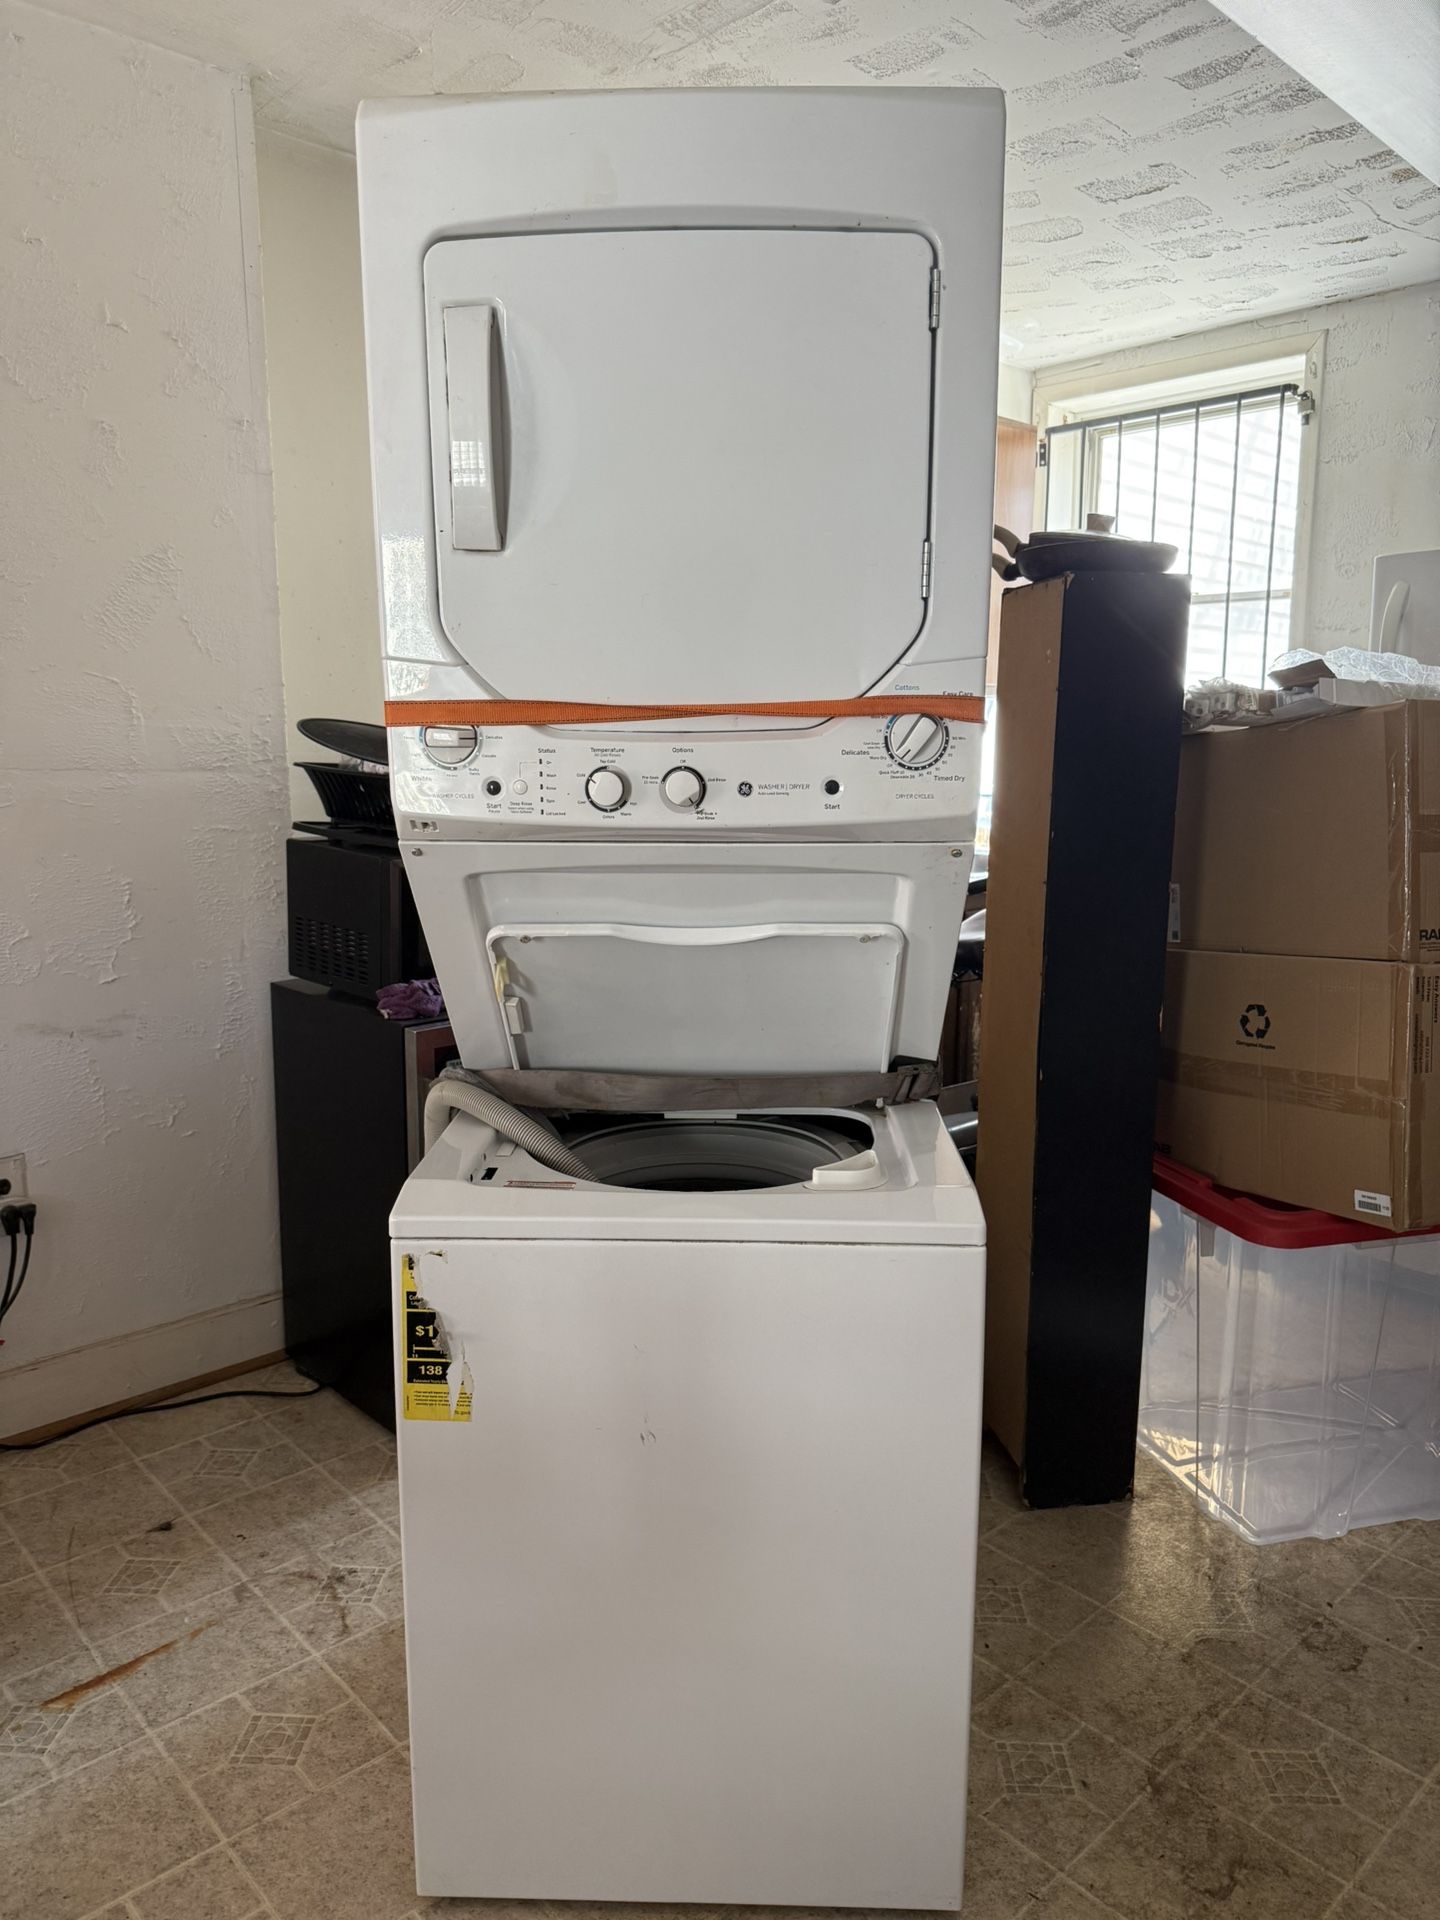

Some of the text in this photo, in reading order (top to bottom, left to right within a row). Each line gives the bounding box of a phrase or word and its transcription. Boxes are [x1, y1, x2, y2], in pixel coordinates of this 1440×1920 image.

[895, 684, 920, 692] Cottons
[954, 775, 965, 783] Dry
[486, 802, 502, 810] Start
[1419, 928, 1440, 941] RA
[418, 1365, 443, 1376] 138
